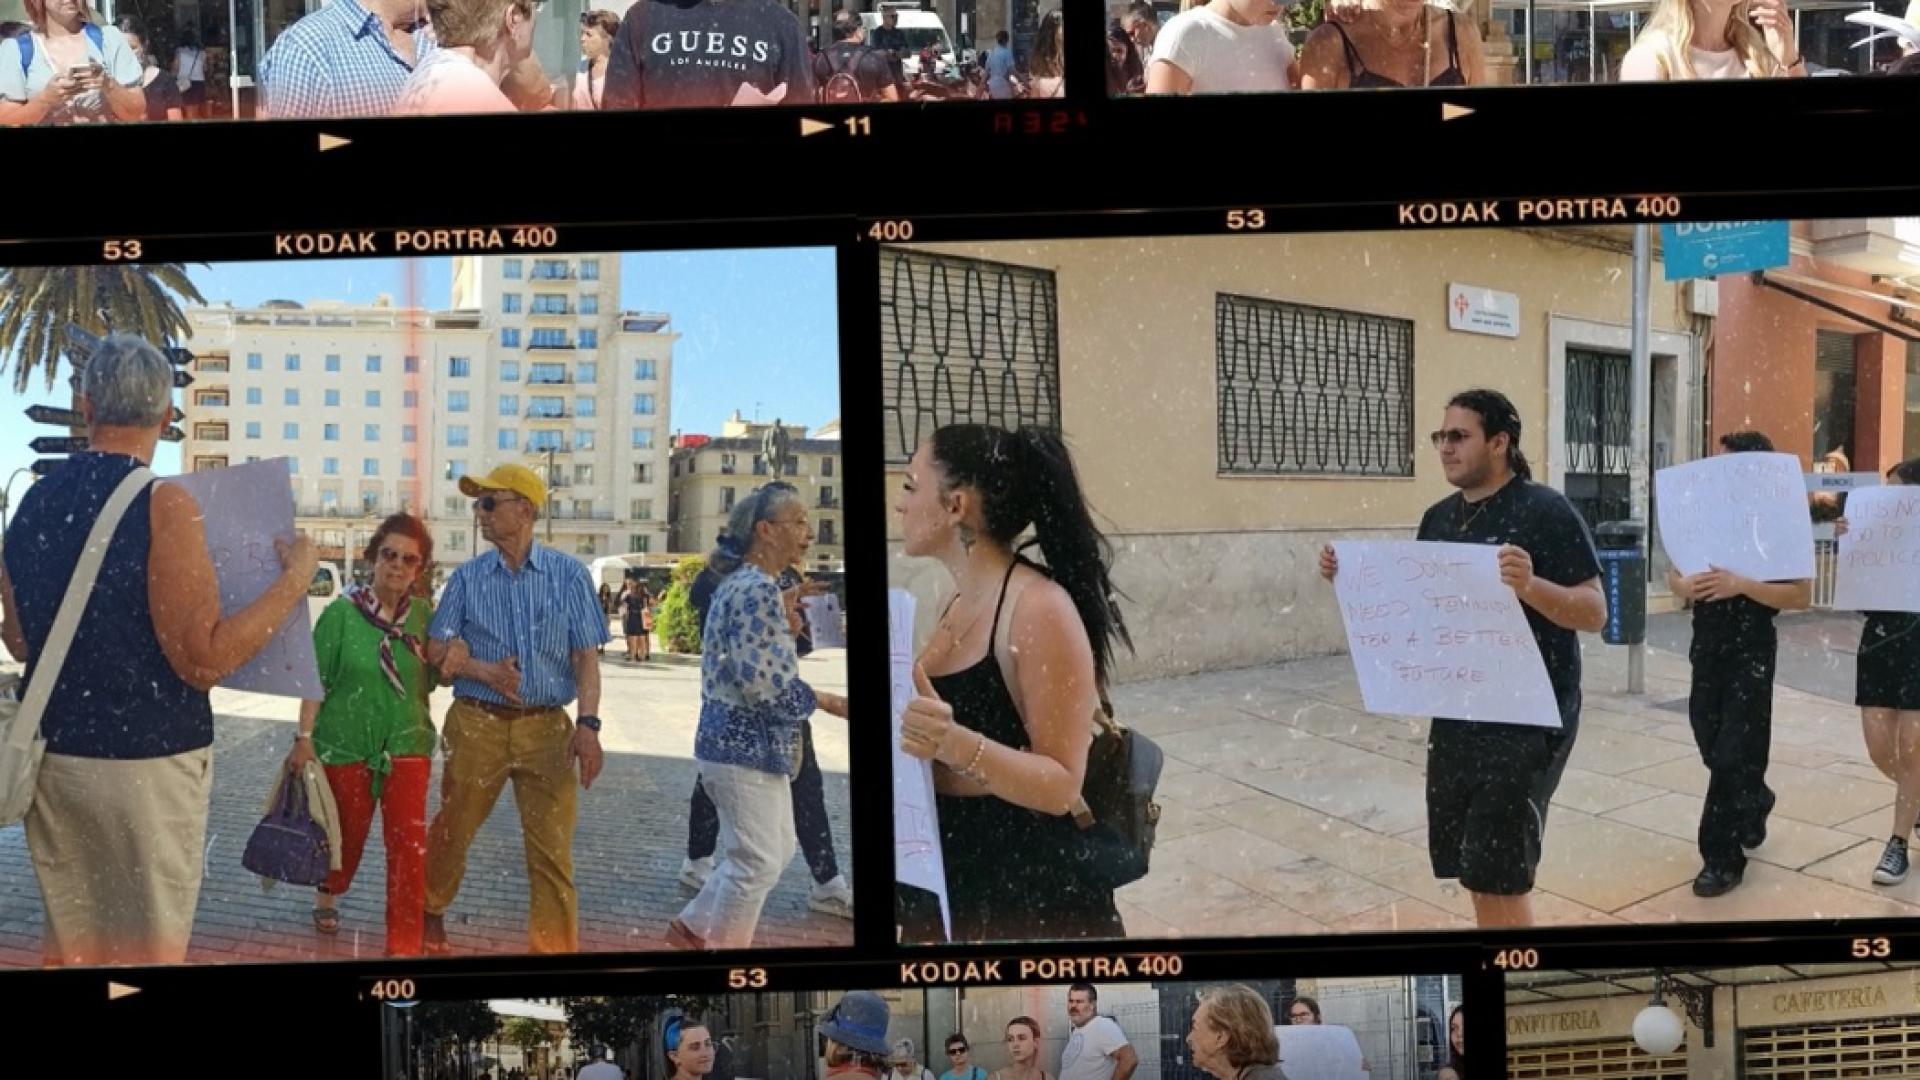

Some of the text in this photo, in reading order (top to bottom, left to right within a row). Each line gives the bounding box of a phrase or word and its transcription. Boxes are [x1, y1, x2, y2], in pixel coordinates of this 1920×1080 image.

[651, 30, 769, 63] GUESS
[1879, 524, 1903, 540] TO
[1346, 555, 1384, 592] WE
[1347, 599, 1410, 623] NEED
[1352, 626, 1529, 650] FOR A BETTER
[1392, 660, 1487, 683] FUTURE
[1773, 985, 1888, 1014] CAFETERIA
